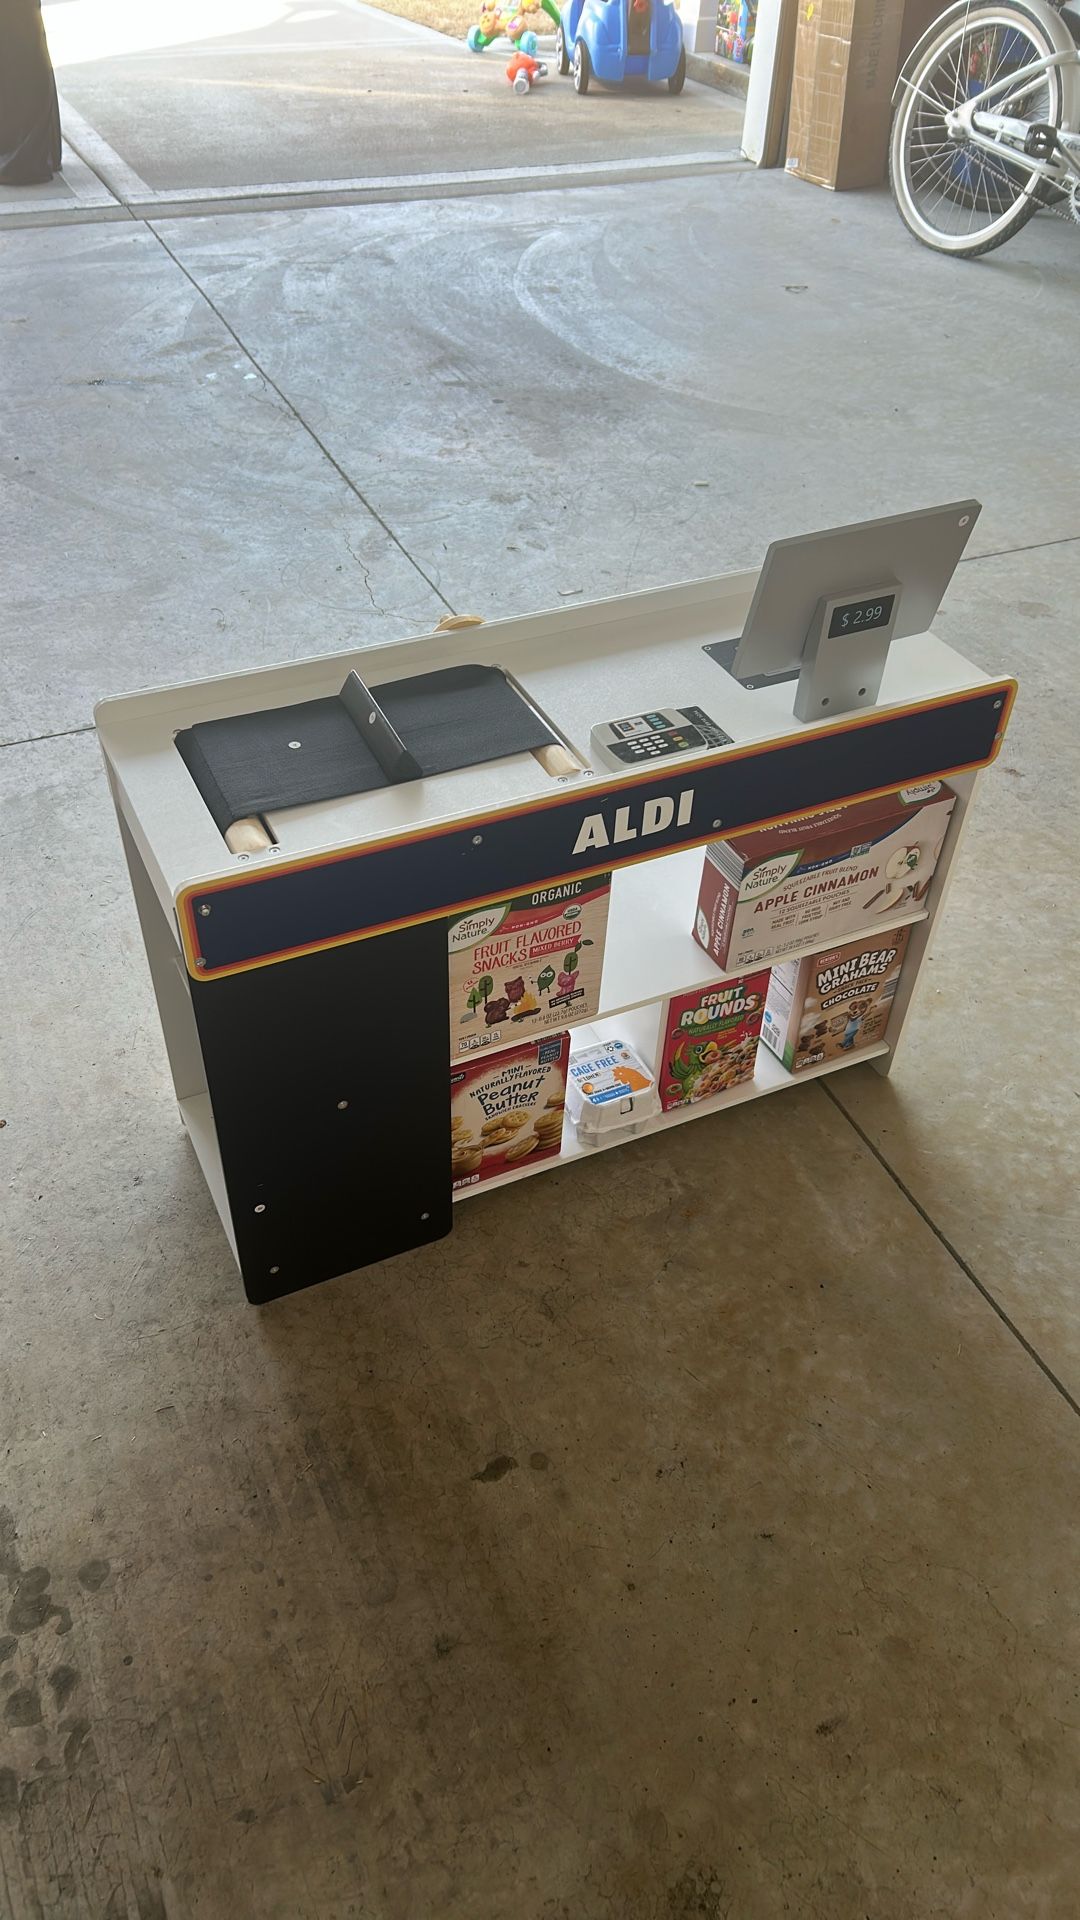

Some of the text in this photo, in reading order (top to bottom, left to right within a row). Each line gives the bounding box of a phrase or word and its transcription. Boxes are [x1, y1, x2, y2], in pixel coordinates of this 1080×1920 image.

[841, 606, 882, 628] $ 2.99
[572, 789, 694, 855] ALDI
[744, 875, 778, 891] Nature
[753, 865, 787, 881] Simply
[783, 865, 858, 892] SQUEEZABLE FRUIT BLEND
[531, 881, 583, 905] ORGANIC
[754, 890, 799, 914] APPLE
[804, 866, 880, 898] CINNAMON
[786, 898, 822, 913] SQUEEZABLE
[823, 889, 850, 901] POUCHES
[717, 883, 731, 930] CINNAMON
[452, 928, 488, 942] Nature
[459, 917, 495, 933] Simply
[474, 921, 582, 960] FRUIT FLAVORED
[533, 938, 574, 953] MIXED BERRY
[713, 929, 722, 957] APPLE
[472, 948, 527, 974] SNACKS
[818, 949, 896, 987] MINI BEAR
[820, 962, 888, 994] GRAHAMS
[701, 986, 744, 1007] FRUIT
[822, 983, 877, 1008] CHOCOLATE
[680, 994, 758, 1026] ROUNDS
[502, 1065, 524, 1077] MINI
[570, 1055, 619, 1077] CAGE FREE
[469, 1074, 515, 1098] NATURALLY
[514, 1066, 552, 1080] FLAVORED
[477, 1075, 546, 1105] Peanut
[512, 1102, 537, 1110] CRACKERS
